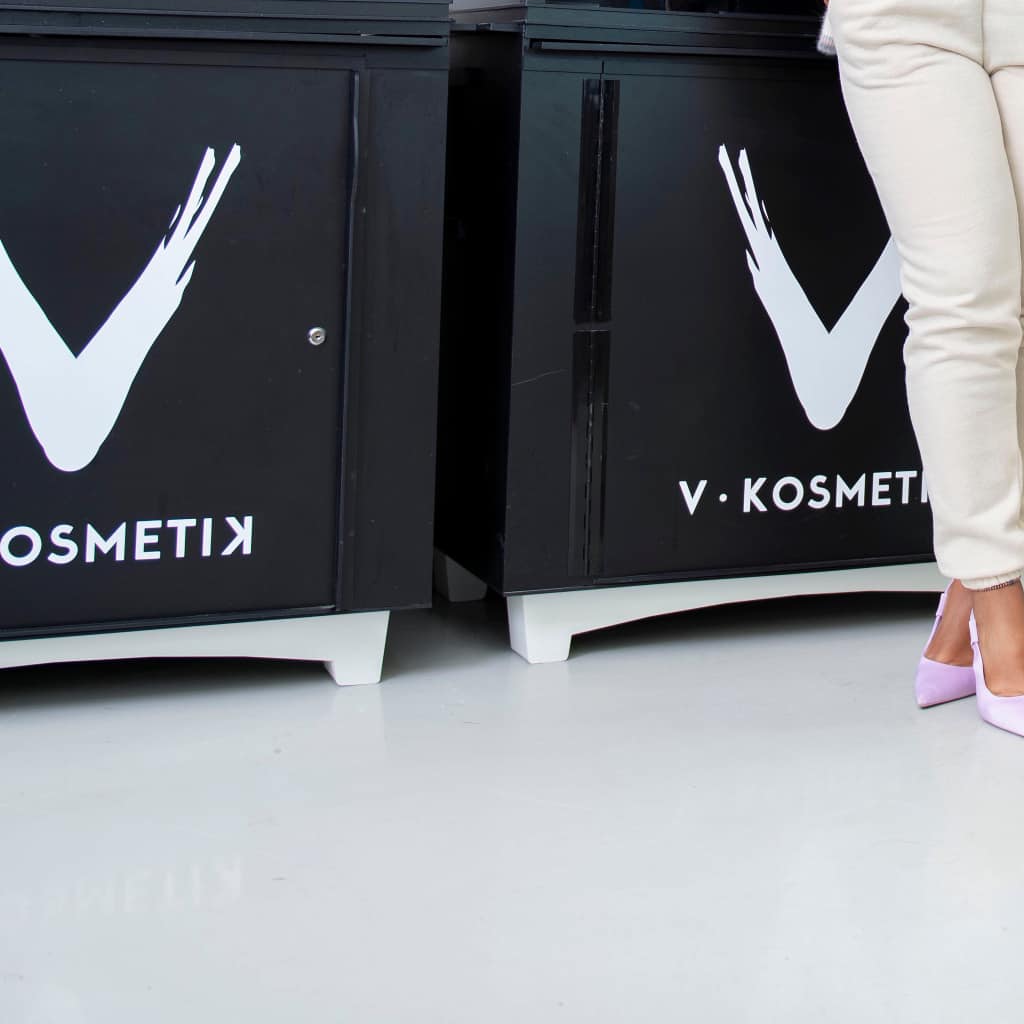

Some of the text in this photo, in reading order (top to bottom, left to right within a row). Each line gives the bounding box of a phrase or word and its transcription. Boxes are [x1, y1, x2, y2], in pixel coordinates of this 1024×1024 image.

[678, 478, 708, 516] V
[742, 469, 928, 514] KOSMETI
[0, 515, 254, 567] OSMETIK
